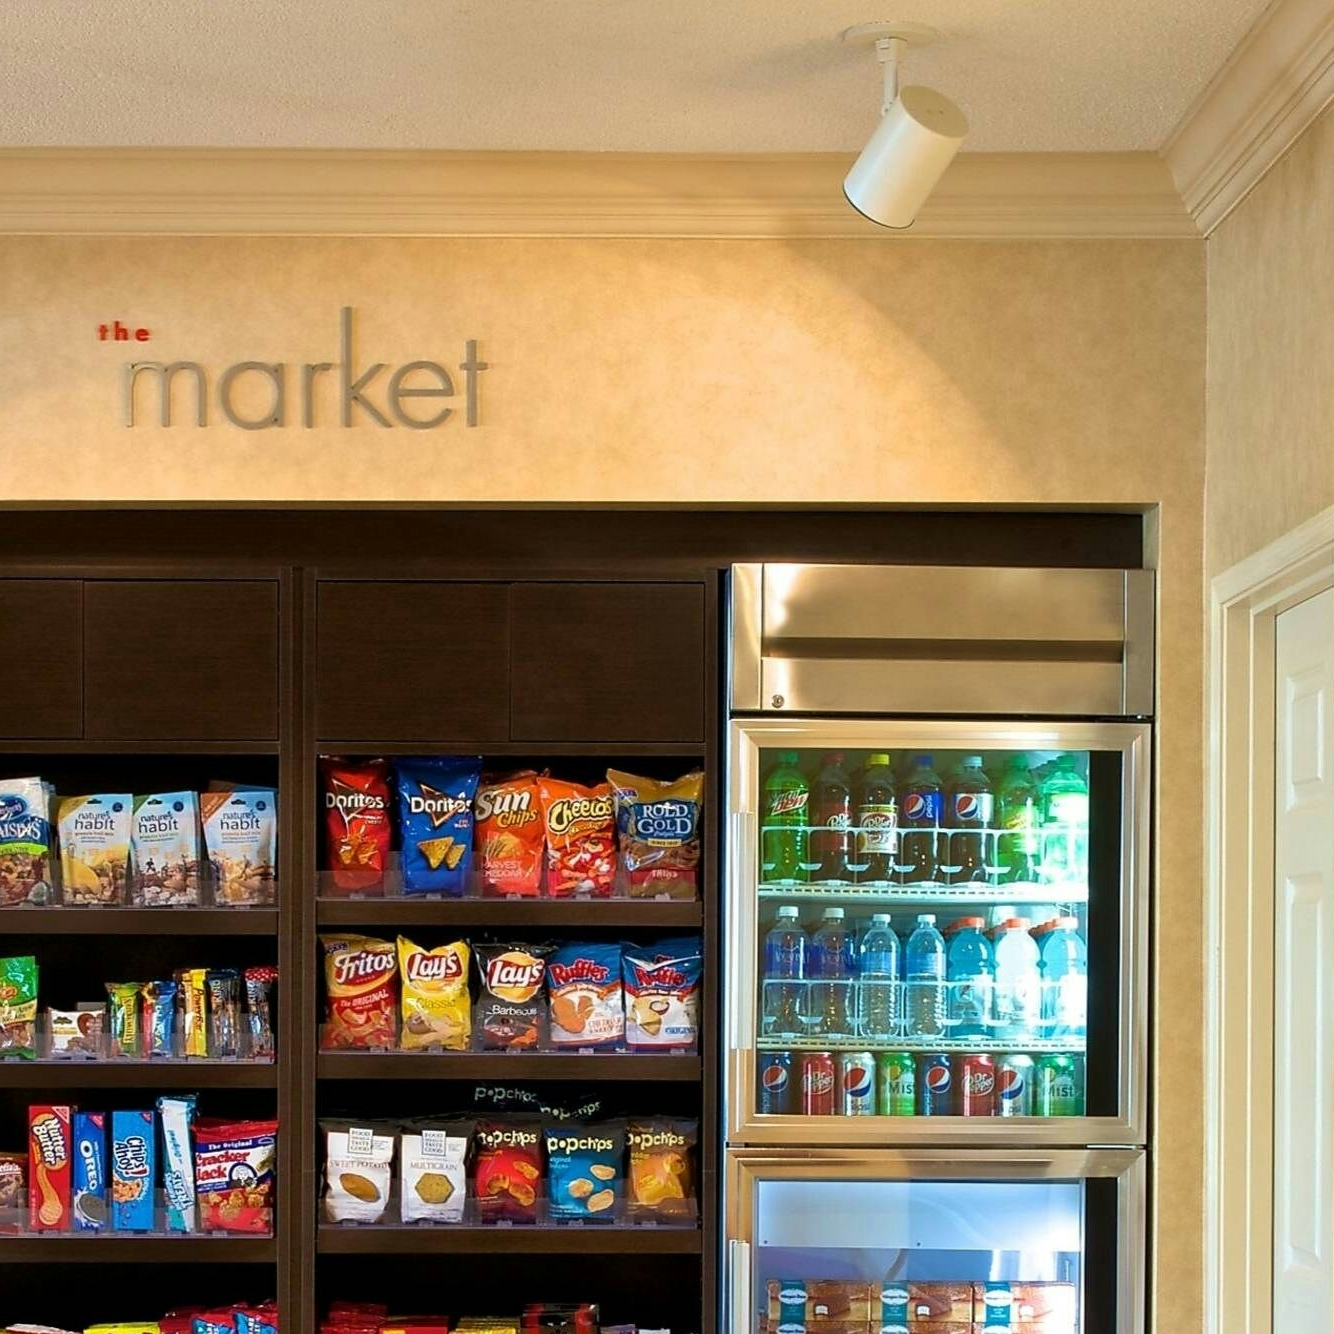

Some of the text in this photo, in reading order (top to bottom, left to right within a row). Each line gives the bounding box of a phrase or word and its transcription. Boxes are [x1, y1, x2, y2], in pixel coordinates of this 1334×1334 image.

[98, 321, 150, 342] the
[124, 306, 489, 430] market
[325, 792, 385, 810] Doritos
[410, 796, 473, 814] Doritos
[475, 790, 531, 821] Sun
[642, 804, 688, 819] ROLD
[220, 818, 261, 831] habit
[497, 808, 538, 828] Chips
[549, 797, 614, 831] Cheetos
[74, 818, 116, 832] habit
[138, 819, 179, 834] habit
[637, 818, 692, 834] GOLD
[334, 951, 395, 983] Fritos
[409, 952, 459, 980] Lay's
[491, 958, 544, 988] Lay's
[553, 958, 608, 986] Ruffles
[636, 966, 687, 987] Ruffles
[32, 1125, 56, 1165] Butter
[45, 1117, 66, 1161] Nutter
[223, 1139, 253, 1149] Original
[546, 1137, 614, 1154] popchips
[126, 1136, 146, 1169] Chips
[196, 1151, 250, 1167] Cracker
[80, 1140, 98, 1190] OREO
